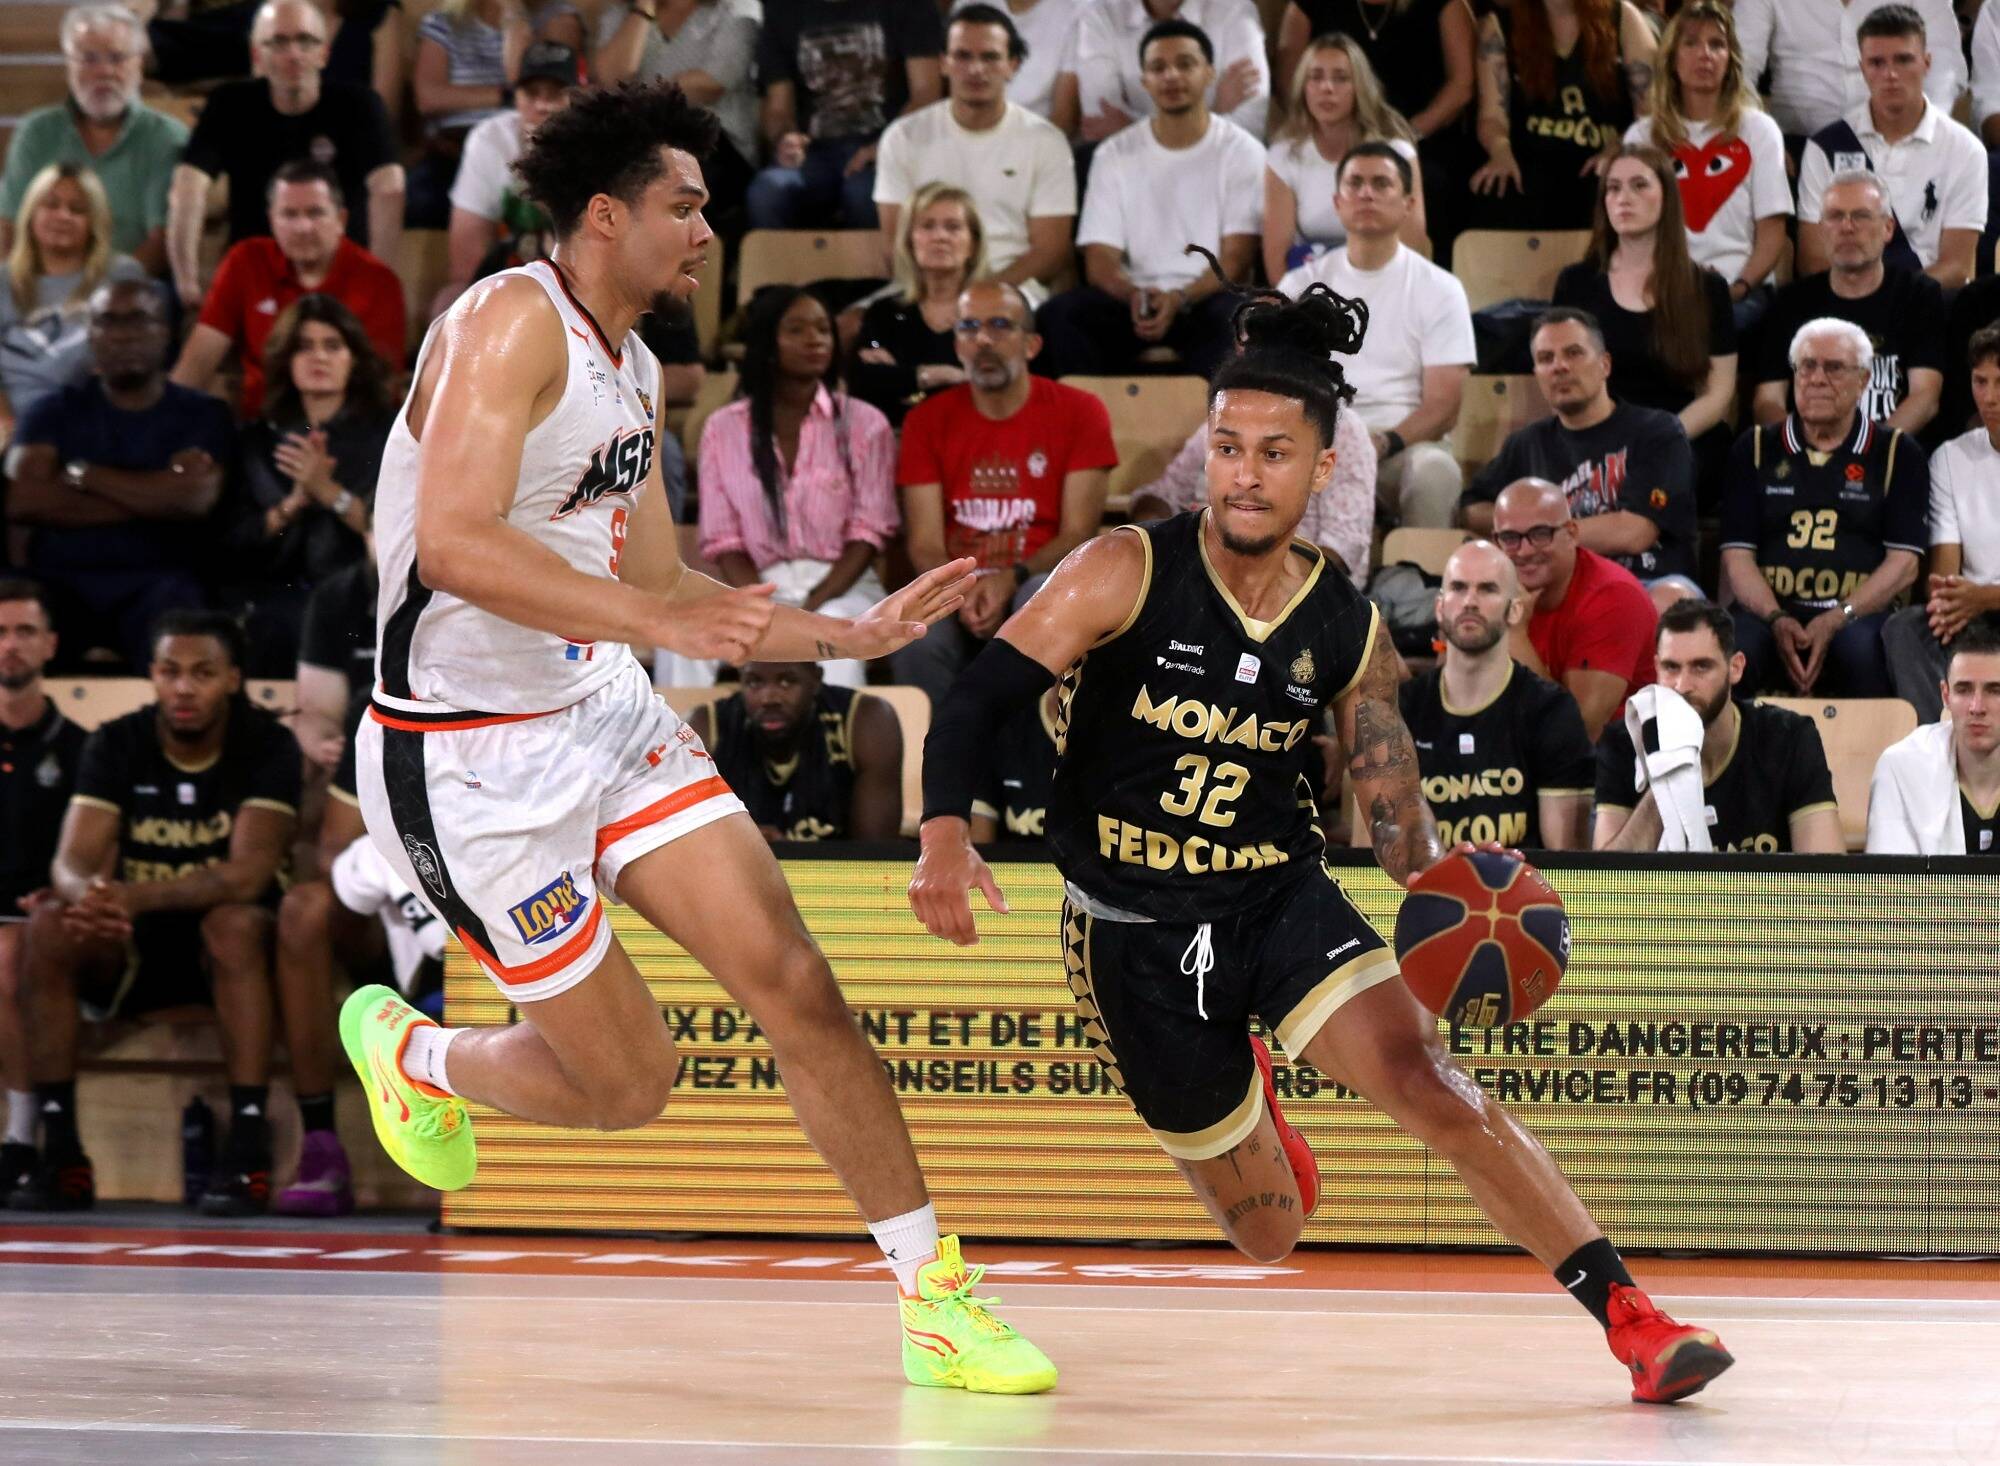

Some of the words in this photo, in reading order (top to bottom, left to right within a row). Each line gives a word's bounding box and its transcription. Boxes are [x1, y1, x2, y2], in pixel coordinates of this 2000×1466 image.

[1787, 509, 1838, 550] 32
[1168, 639, 1204, 656] SPALDING
[1131, 683, 1311, 752] MONACO
[1159, 753, 1251, 828] 32
[1326, 937, 1361, 960] SPALDING
[929, 1009, 977, 1046] ET
[990, 1012, 1041, 1048] DE
[1568, 1021, 1828, 1060] DANGEREUX
[1864, 1026, 1999, 1062] PERTE
[1687, 1070, 1749, 1110] (09
[1758, 1072, 1805, 1106] 74
[1815, 1073, 1861, 1107] 75
[1872, 1075, 1916, 1109] 13
[1929, 1075, 1973, 1109] 13
[1260, 1192, 1275, 1207] OF
[1279, 1194, 1295, 1212] MY
